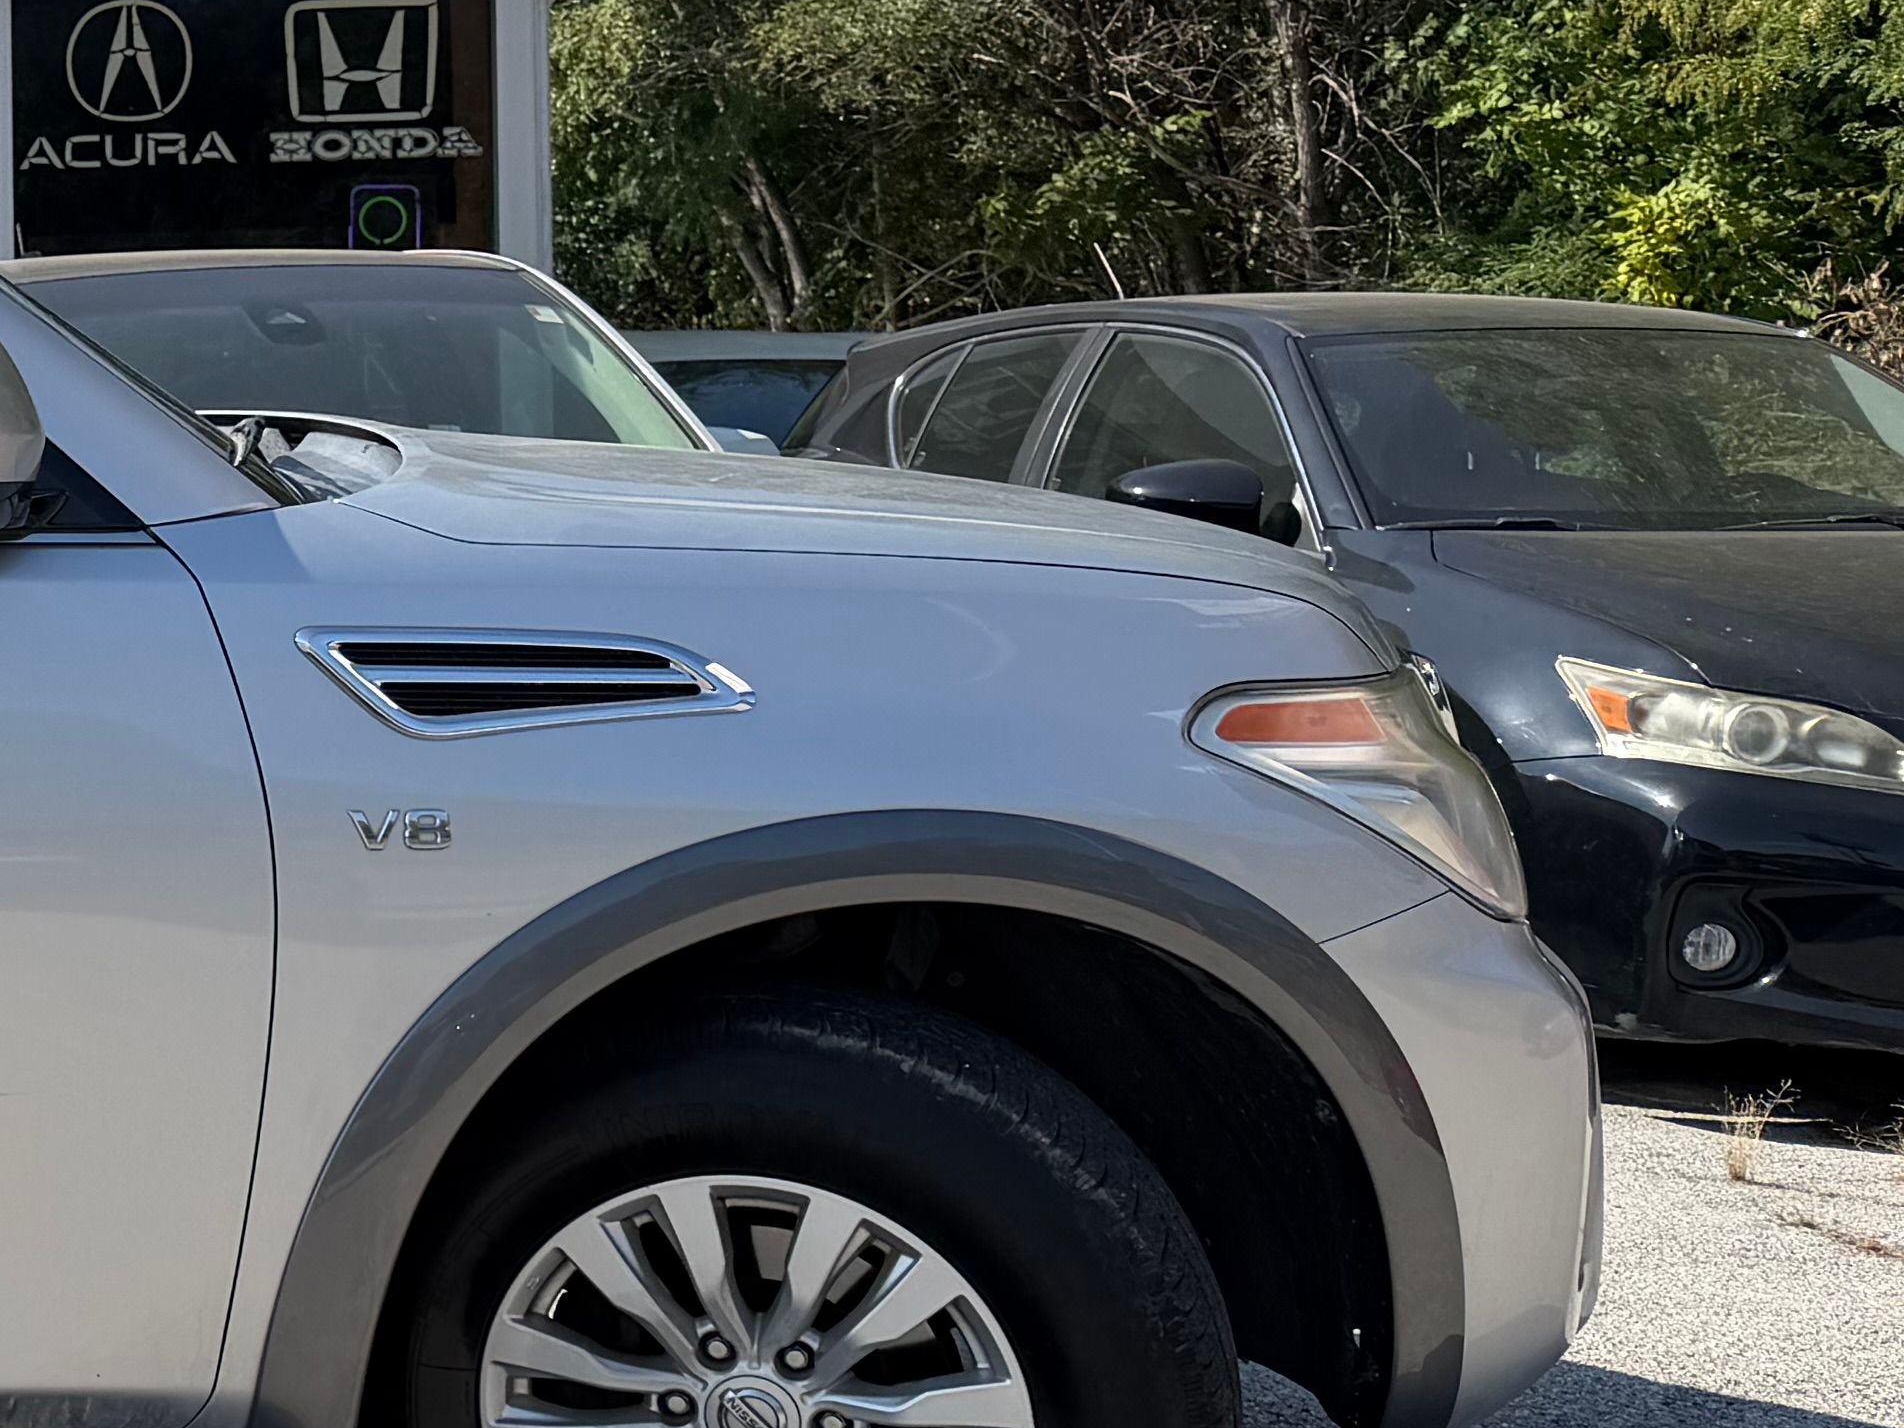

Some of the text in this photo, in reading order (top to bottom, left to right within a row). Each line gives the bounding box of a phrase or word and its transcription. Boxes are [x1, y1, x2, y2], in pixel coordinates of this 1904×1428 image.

[18, 130, 238, 171] ACURA
[268, 125, 484, 163] HONDA
[347, 808, 452, 851] V8
